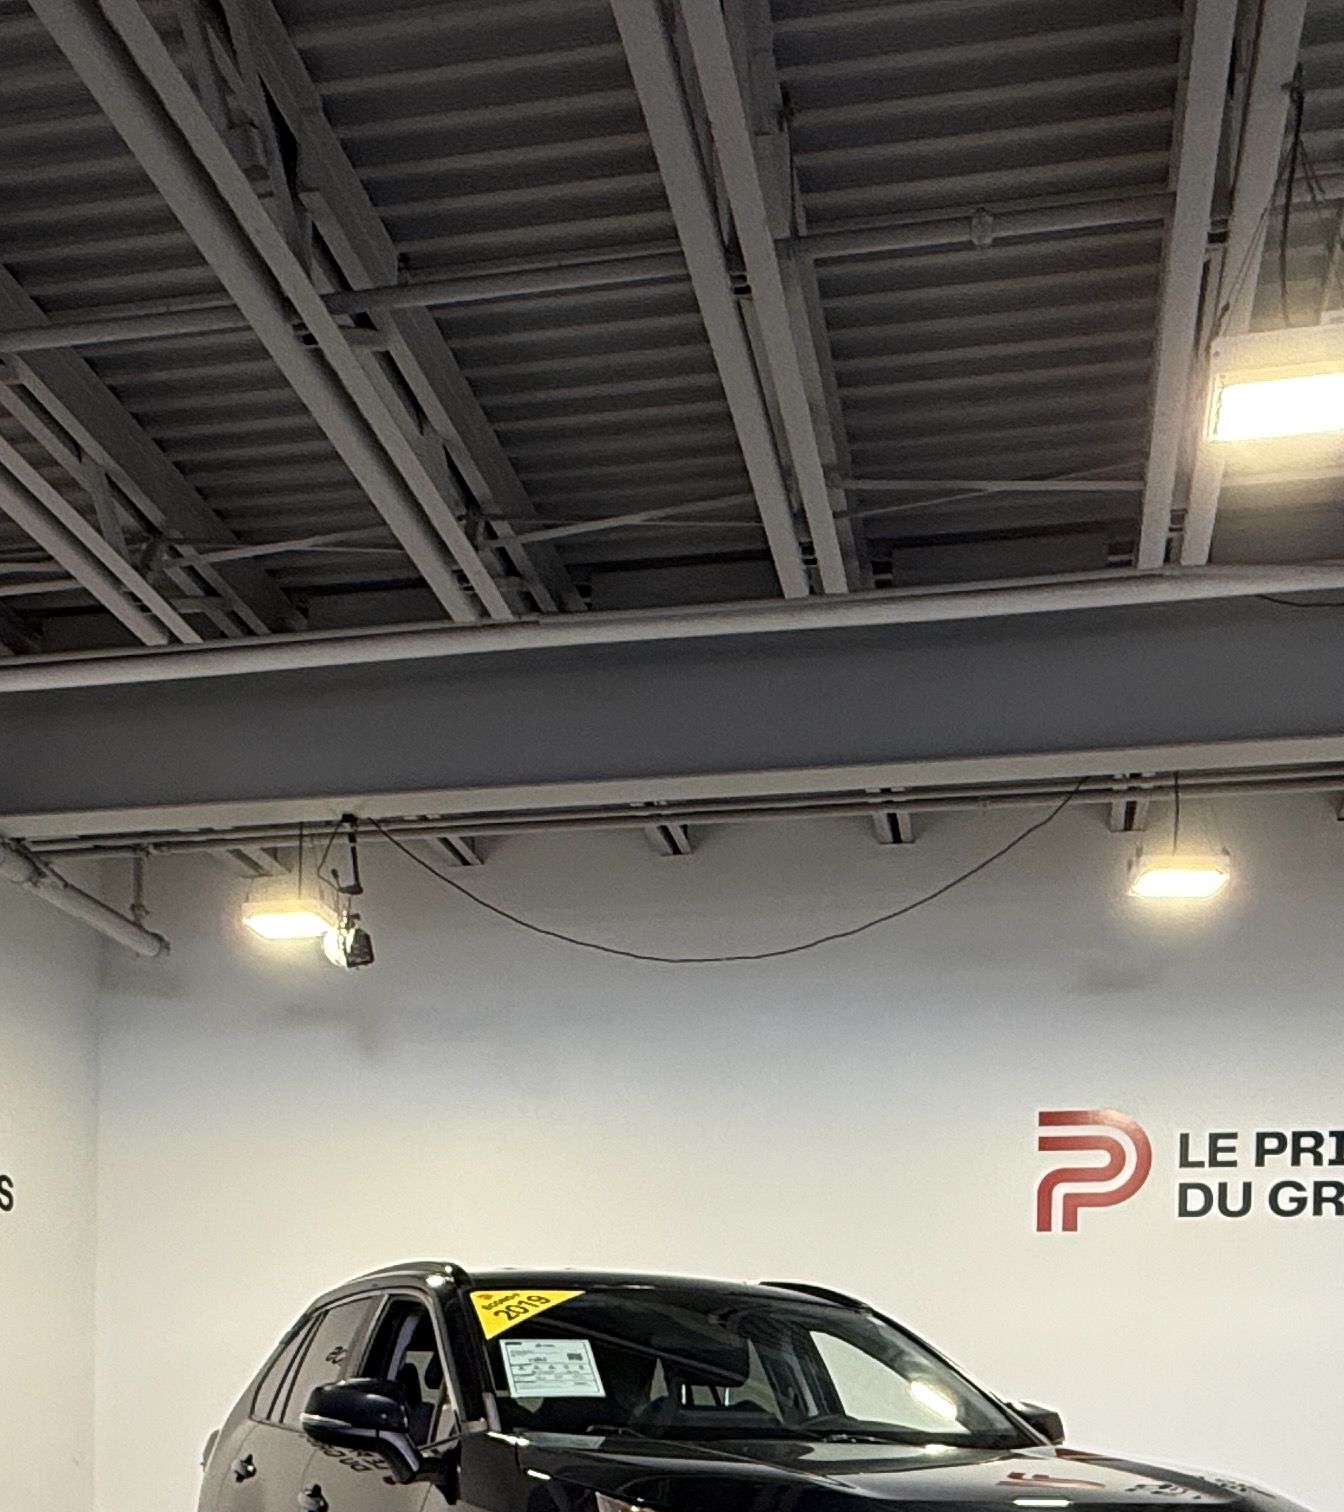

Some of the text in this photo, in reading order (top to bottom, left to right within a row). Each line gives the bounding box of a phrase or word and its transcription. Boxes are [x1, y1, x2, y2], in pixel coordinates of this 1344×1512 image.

[1178, 1132, 1239, 1168] LE
[1178, 1181, 1252, 1218] DU
[493, 1295, 551, 1321] 2019
